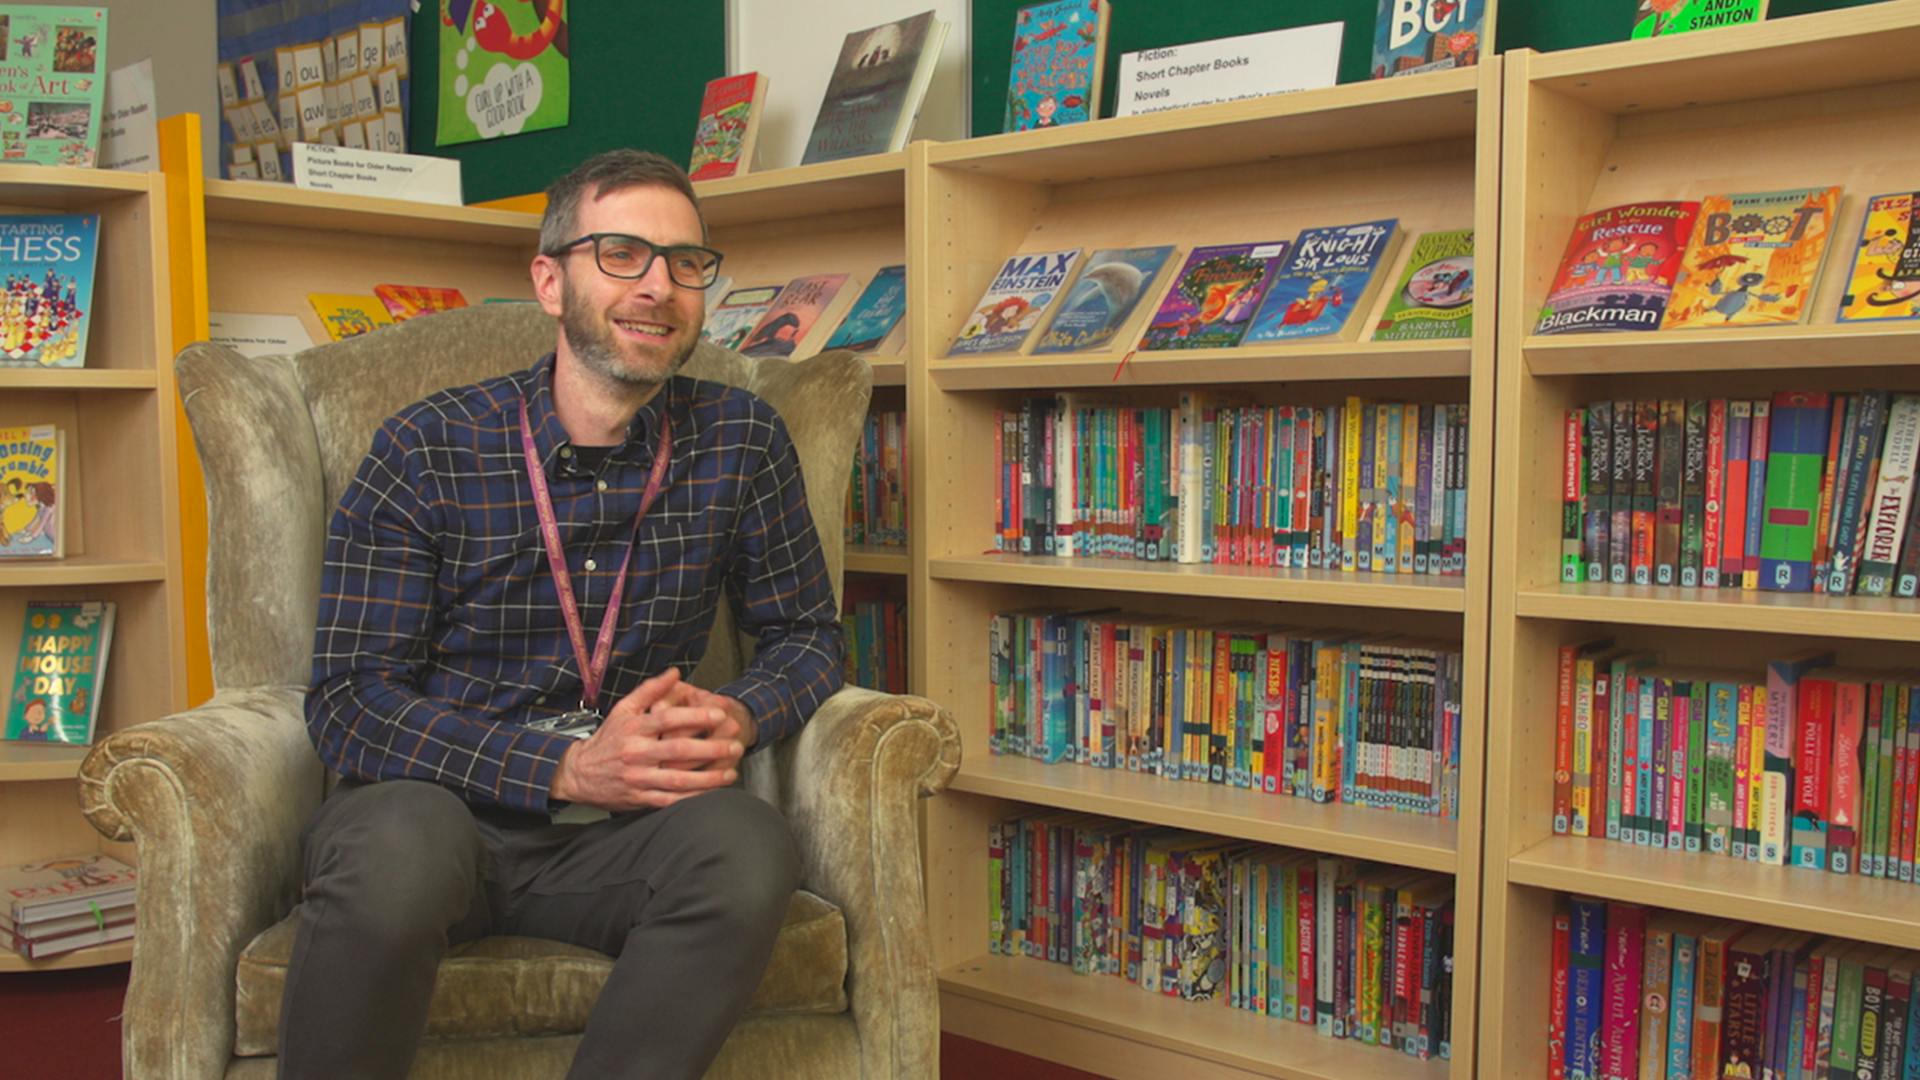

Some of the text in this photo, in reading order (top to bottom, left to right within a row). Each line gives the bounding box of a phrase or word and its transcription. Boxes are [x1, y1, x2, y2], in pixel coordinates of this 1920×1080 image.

[1689, 8, 1754, 30] STANTON
[364, 46, 378, 67] ge
[388, 40, 405, 58] wh
[1137, 48, 1177, 62] Fiction:
[340, 52, 356, 68] mb
[301, 66, 320, 81] ou
[1136, 56, 1249, 82] Short Chapter Books
[31, 76, 70, 95] Art
[526, 69, 534, 88] A
[1134, 88, 1170, 102] Novels
[304, 104, 324, 121] aw
[307, 156, 332, 166] Picture
[367, 162, 384, 170] Older
[386, 164, 413, 172] Readers
[308, 169, 327, 178] Short
[329, 171, 354, 180] Chapter
[1578, 206, 1690, 232] Girl Wonder
[1592, 224, 1663, 242] Rescue
[1300, 229, 1386, 258] KNIGHT
[1000, 251, 1078, 278] MAX
[1292, 254, 1371, 271] SIR LOUIS
[991, 274, 1064, 292] EINSTEIN
[1539, 306, 1657, 332] Blackman
[1870, 495, 1902, 562] EXPLORER
[1566, 568, 1574, 578] R
[1590, 566, 1600, 578] R
[1614, 568, 1624, 579] R
[1638, 569, 1646, 580] R
[1660, 568, 1668, 578] R
[1684, 572, 1693, 582] R
[1705, 570, 1714, 580] R
[1778, 568, 1788, 580] R
[1832, 576, 1842, 586] R
[1902, 579, 1912, 590] S
[28, 634, 92, 653] HAPPY
[22, 654, 93, 674] MOUSE
[33, 676, 77, 696] DAY
[1656, 698, 1668, 720] GUM
[1769, 691, 1779, 748] MYSTERY
[1802, 722, 1816, 806] POLLY WOLF
[1558, 818, 1565, 830] S
[1768, 802, 1776, 838] STEVENS
[1639, 831, 1646, 841] S
[1671, 836, 1678, 846] S
[1712, 836, 1720, 847] S
[1767, 848, 1775, 858] S
[1805, 852, 1813, 862] S
[1836, 857, 1844, 868] S
[1864, 986, 1881, 1012] BOY
[1573, 968, 1588, 1070] DEMON DENTIST
[1728, 992, 1740, 1038] STARS
[1744, 992, 1756, 1044] LITTLE
[1610, 972, 1627, 1078] AWFUL AUNTIE
